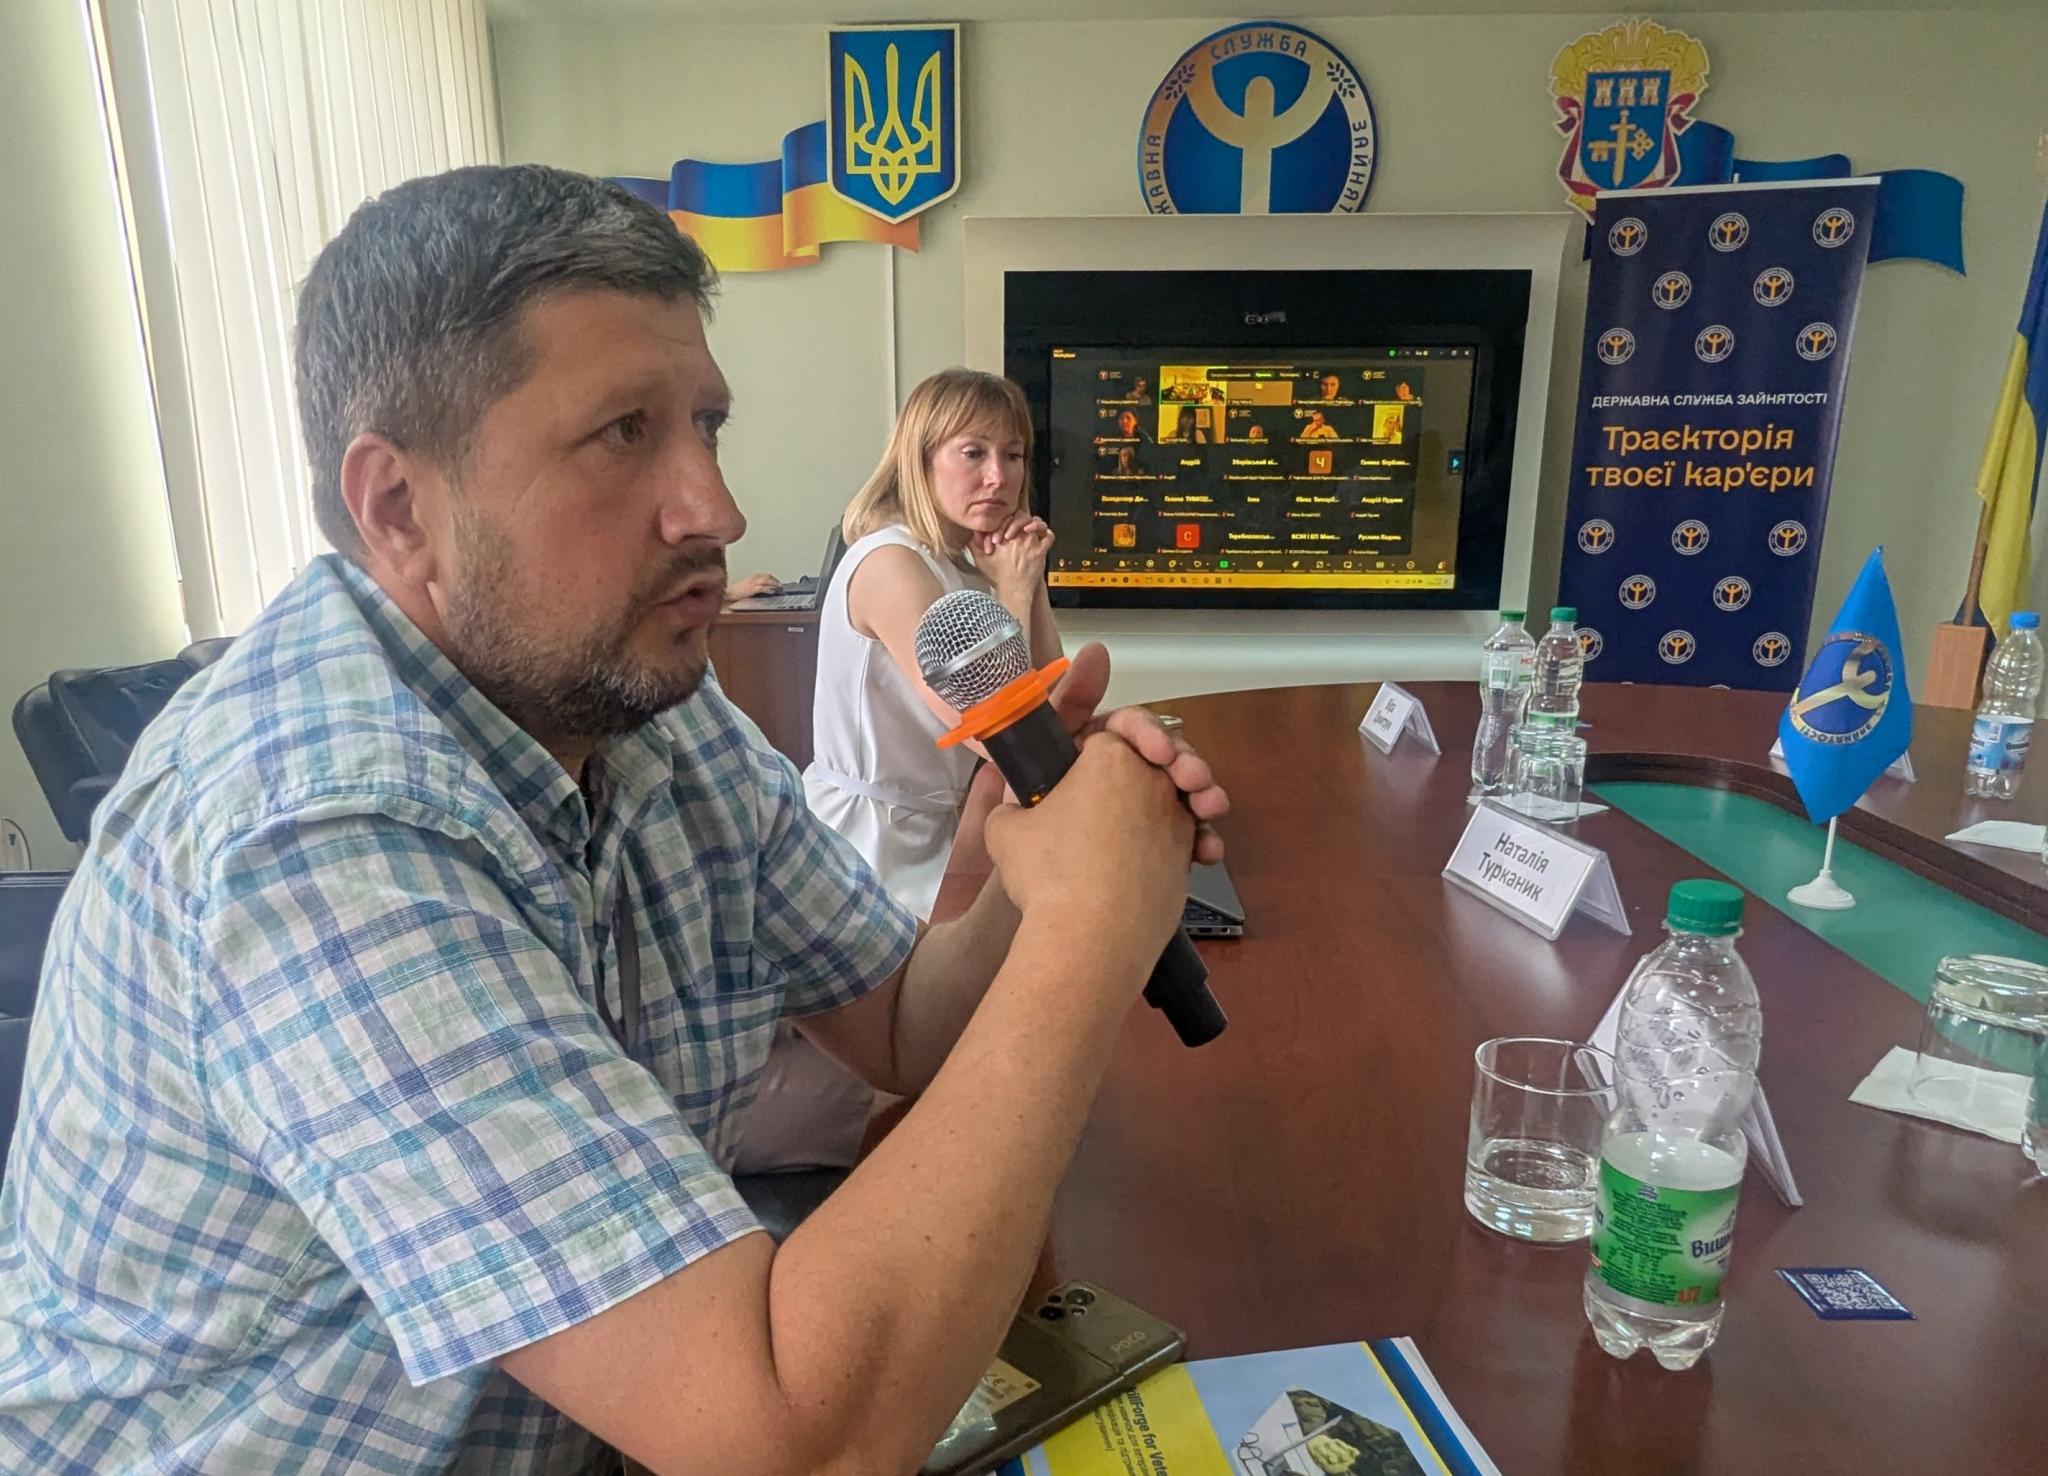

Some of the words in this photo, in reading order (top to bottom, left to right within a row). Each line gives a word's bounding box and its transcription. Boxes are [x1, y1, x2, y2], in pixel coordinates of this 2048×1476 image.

[1210, 31, 1307, 59] СЛУЖБА
[1592, 395, 1670, 408] ДЕРЖАВНА
[1673, 394, 1734, 406] СЛУЖБА
[1736, 391, 1828, 405] ЗАЙНЯТОСТІ
[1602, 423, 1795, 456] Траєкторія
[1585, 461, 1677, 487] твоєї
[1684, 461, 1815, 493] кар'єри
[1493, 831, 1550, 874] Наталія
[1478, 851, 1544, 902] Турканик
[1110, 1330, 1147, 1355] POCO
[1142, 1432, 1158, 1450] for
